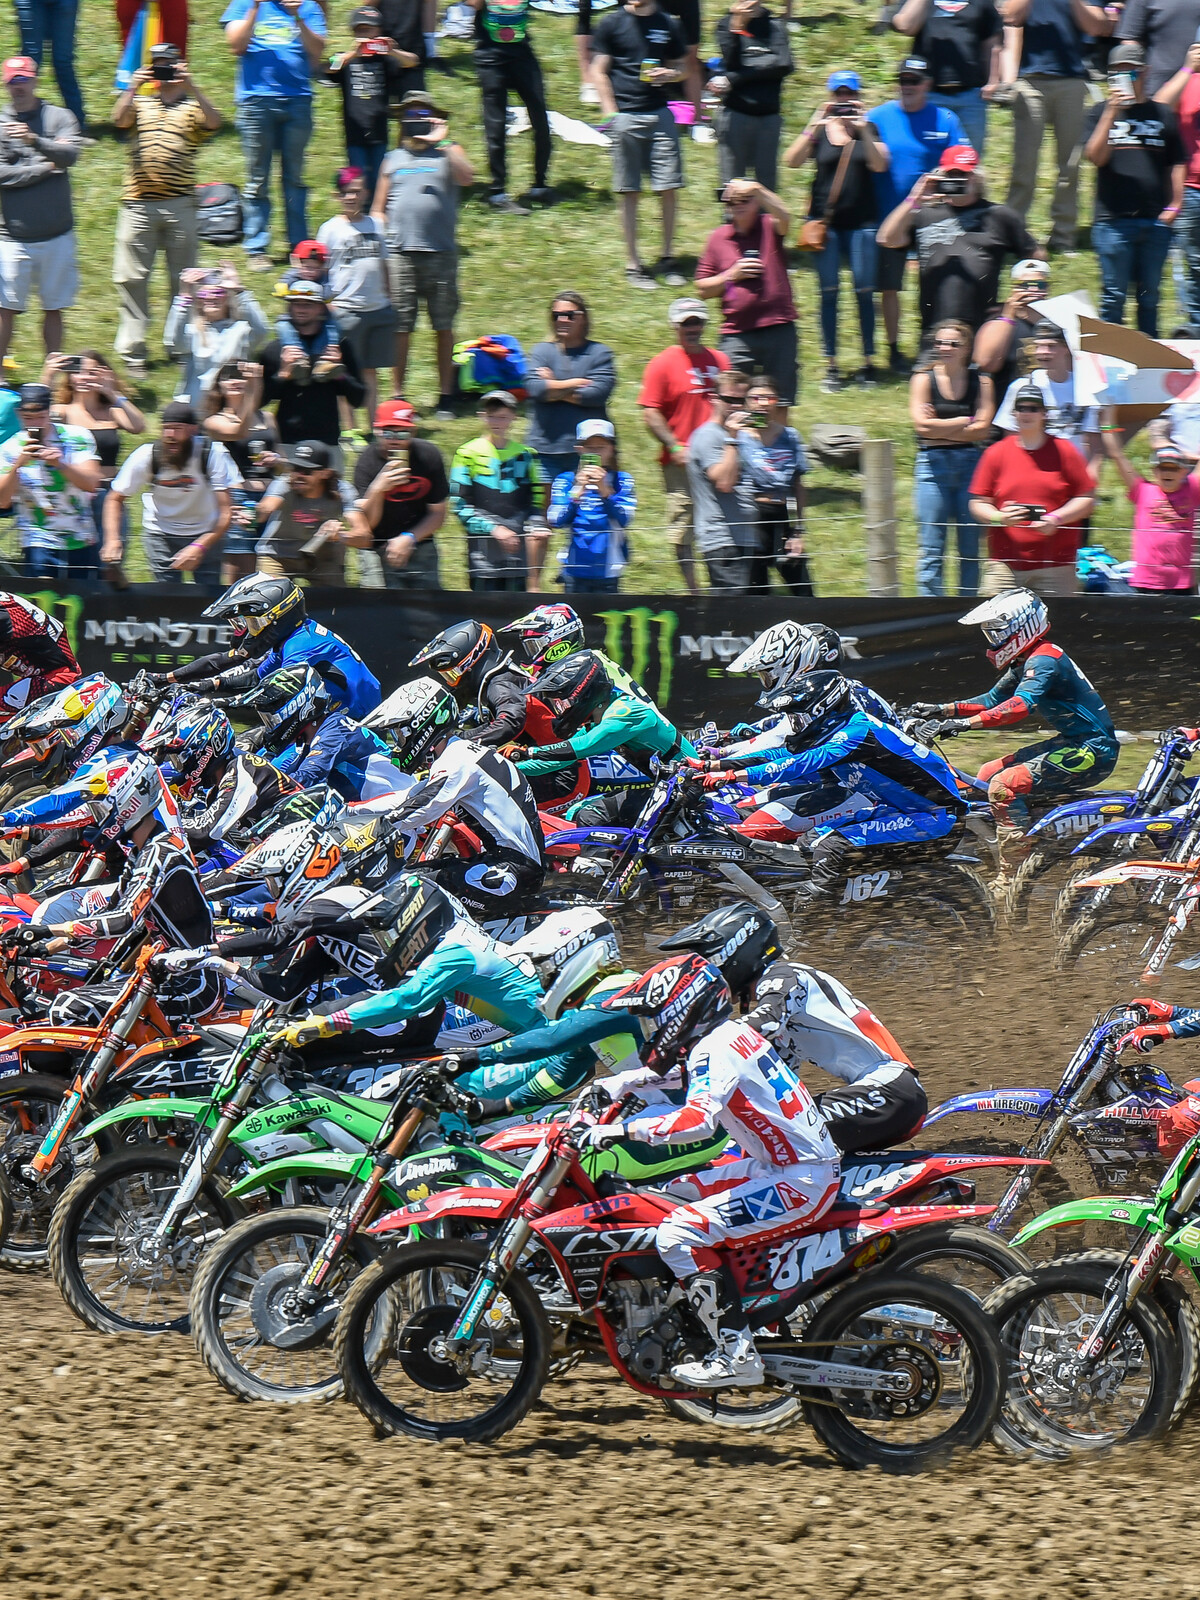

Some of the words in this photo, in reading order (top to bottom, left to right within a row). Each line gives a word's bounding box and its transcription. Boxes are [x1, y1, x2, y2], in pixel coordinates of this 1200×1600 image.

[410, 695, 440, 729] OAKLEY
[285, 830, 315, 874] OAKLEY
[397, 886, 424, 934] LEATT
[394, 920, 430, 977] LEATT
[265, 1102, 332, 1128] Kawasaki
[977, 1098, 1040, 1116] MXTIRE.COM
[719, 1183, 809, 1227] FXR
[465, 1283, 492, 1325] MOTOREX
